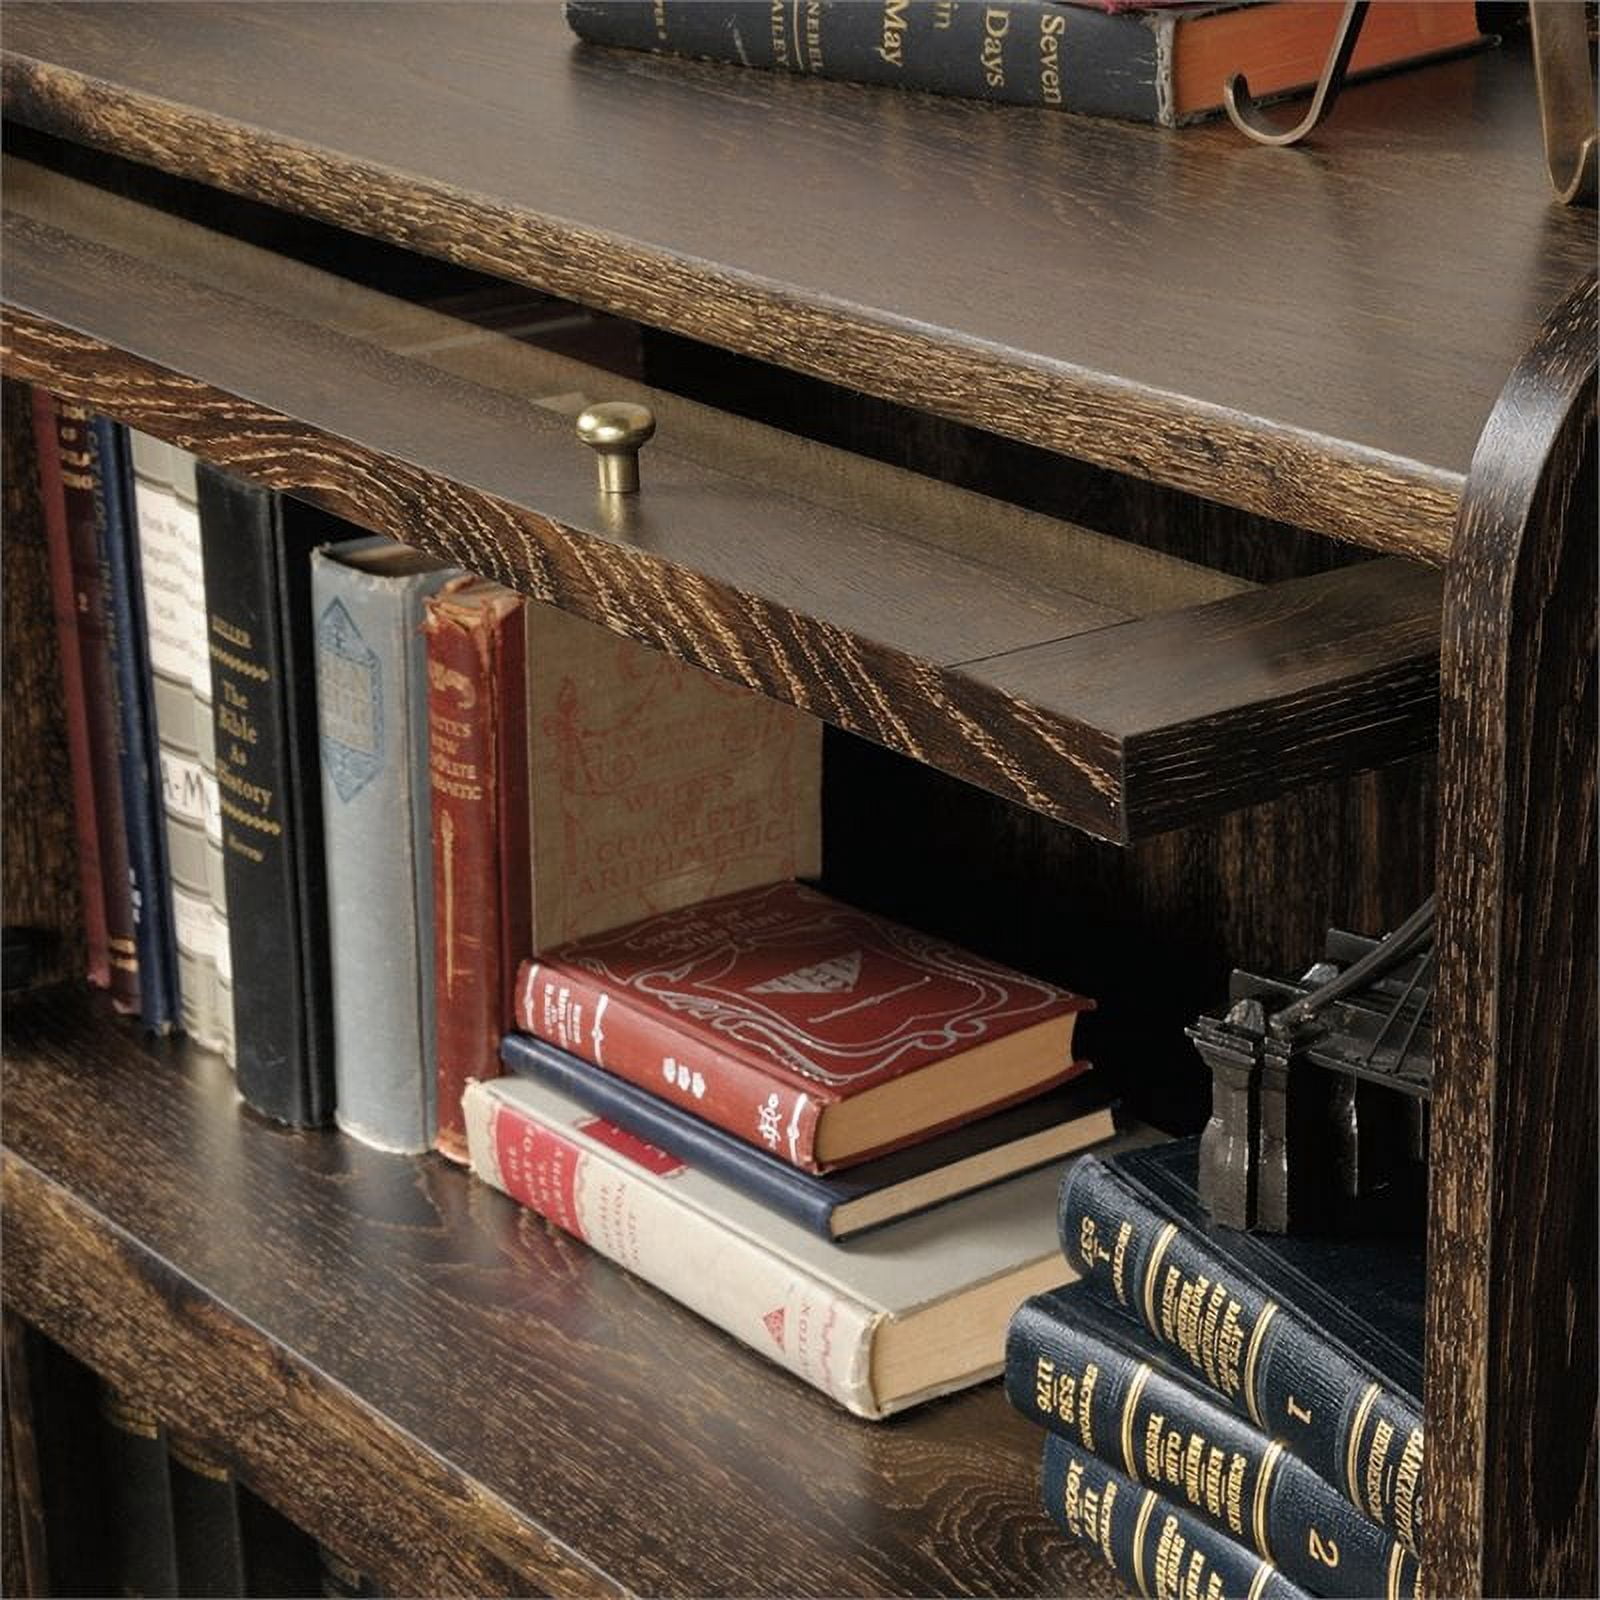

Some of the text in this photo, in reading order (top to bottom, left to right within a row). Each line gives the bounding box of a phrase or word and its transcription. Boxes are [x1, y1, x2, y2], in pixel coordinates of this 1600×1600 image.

[874, 0, 909, 67] May
[980, 10, 1010, 88] Days
[1040, 14, 1066, 104] Seven
[578, 818, 783, 895] ARITHMETIC
[1037, 1356, 1054, 1413] 1176
[1059, 1374, 1075, 1424] 538
[1079, 1363, 1098, 1452] SECTIONS
[1288, 1395, 1312, 1424] 1
[1367, 1418, 1395, 1525] HENDERSON
[1309, 1528, 1339, 1568] 2
